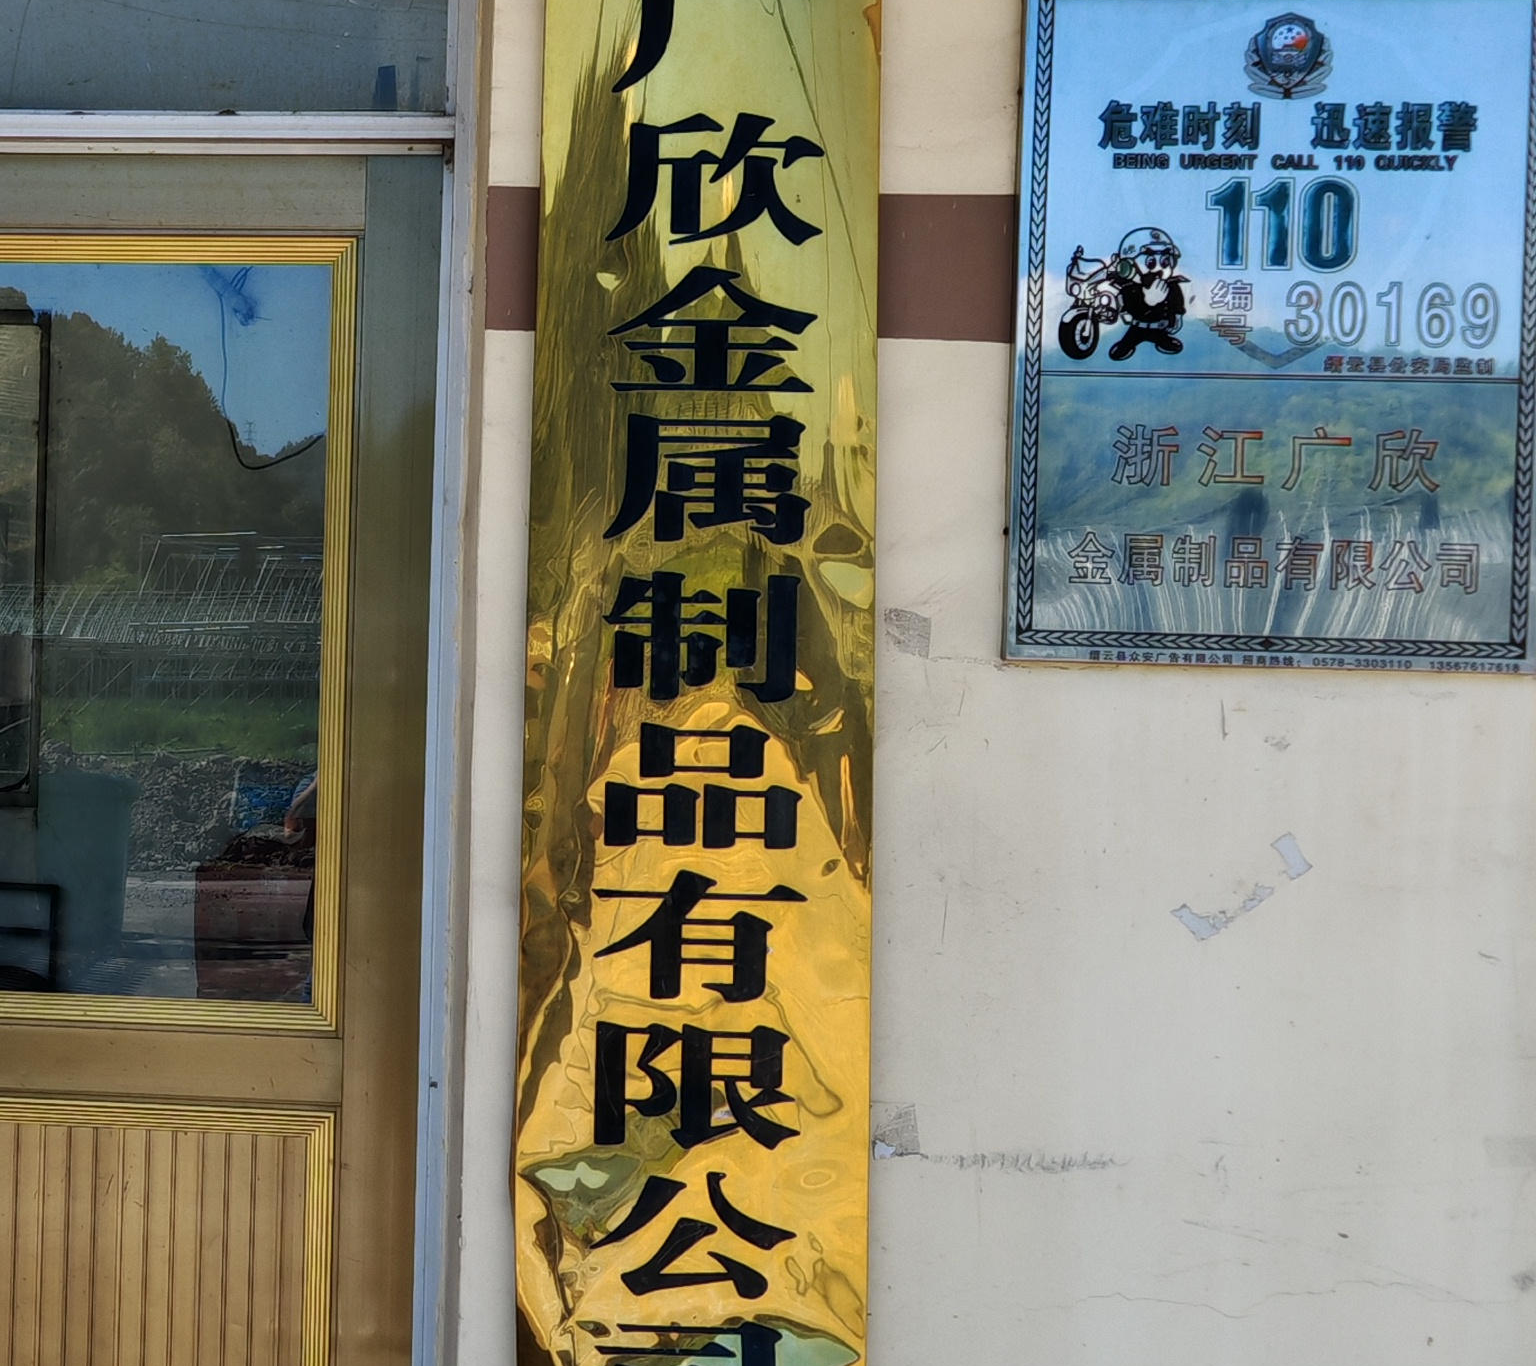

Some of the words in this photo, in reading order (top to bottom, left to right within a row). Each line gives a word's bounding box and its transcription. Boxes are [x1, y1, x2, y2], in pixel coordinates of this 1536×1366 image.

[1097, 100, 1262, 150] 危难时刻
[1310, 101, 1478, 152] 迅速报警
[1113, 152, 1170, 169] BEING
[1179, 153, 1258, 170] URGENT
[1270, 153, 1319, 170] CALL
[1333, 154, 1365, 171] 110
[1374, 154, 1460, 171] QUICKLY
[1205, 175, 1360, 273] 110
[1209, 280, 1254, 346] 编号
[1283, 280, 1500, 349] 30169
[1111, 424, 1441, 494] 浙江广欣
[1067, 531, 1483, 596] 金属制品有限公司
